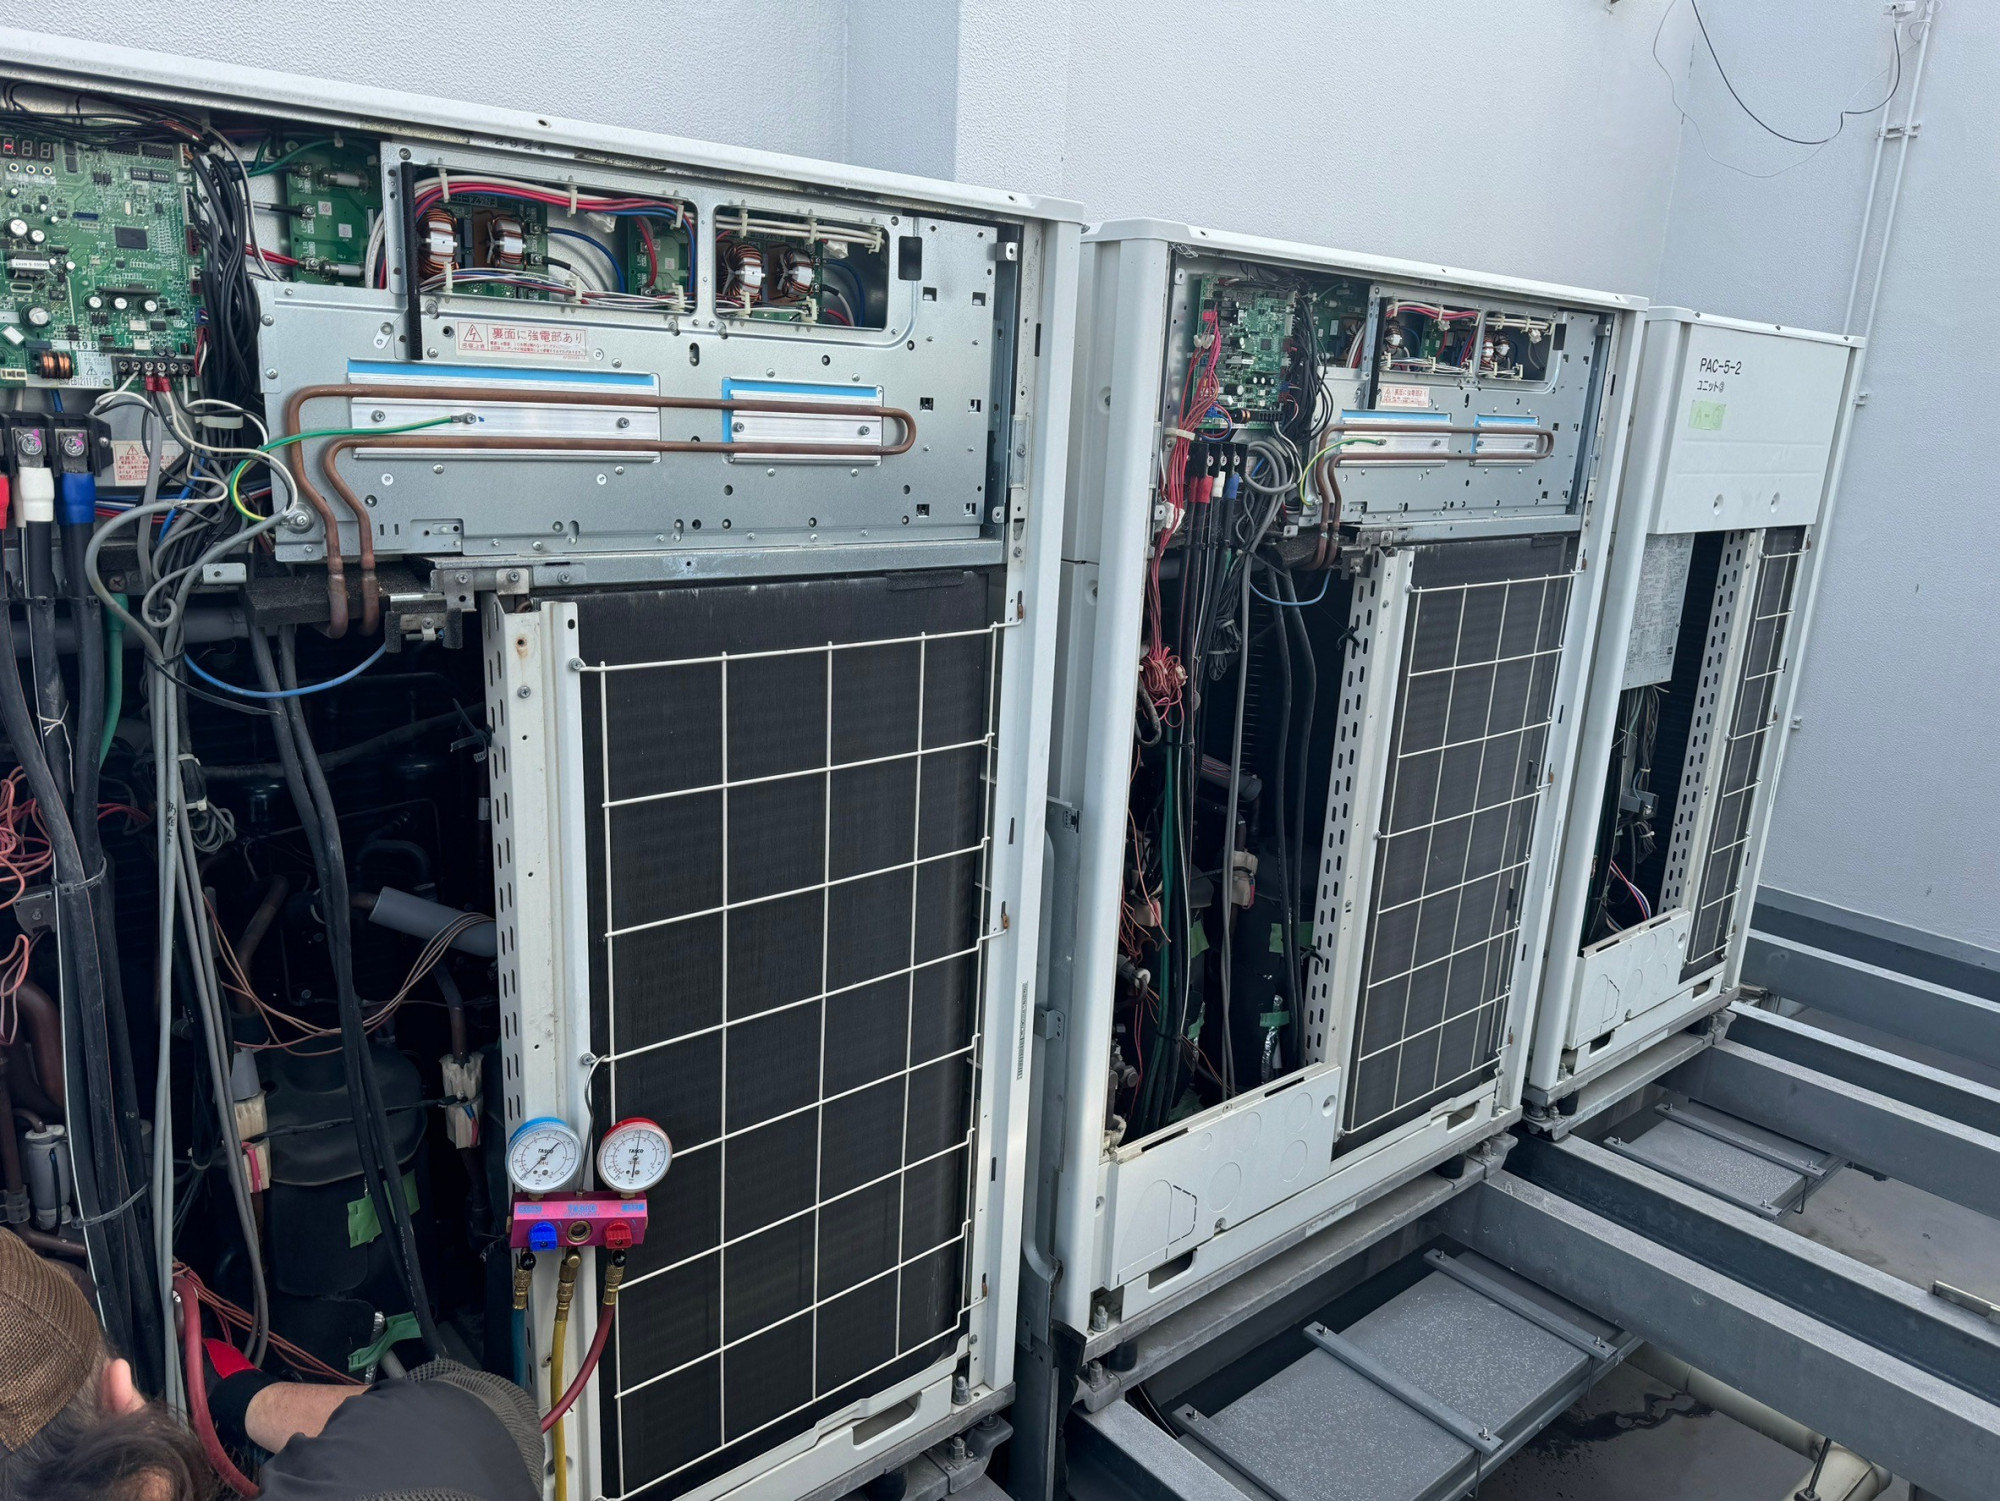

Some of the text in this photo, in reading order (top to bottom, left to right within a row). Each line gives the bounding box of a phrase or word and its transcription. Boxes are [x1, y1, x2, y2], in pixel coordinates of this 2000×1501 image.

[491, 327, 583, 344] 裏面に強電部あり
[1699, 357, 1742, 375] PAC-5-2
